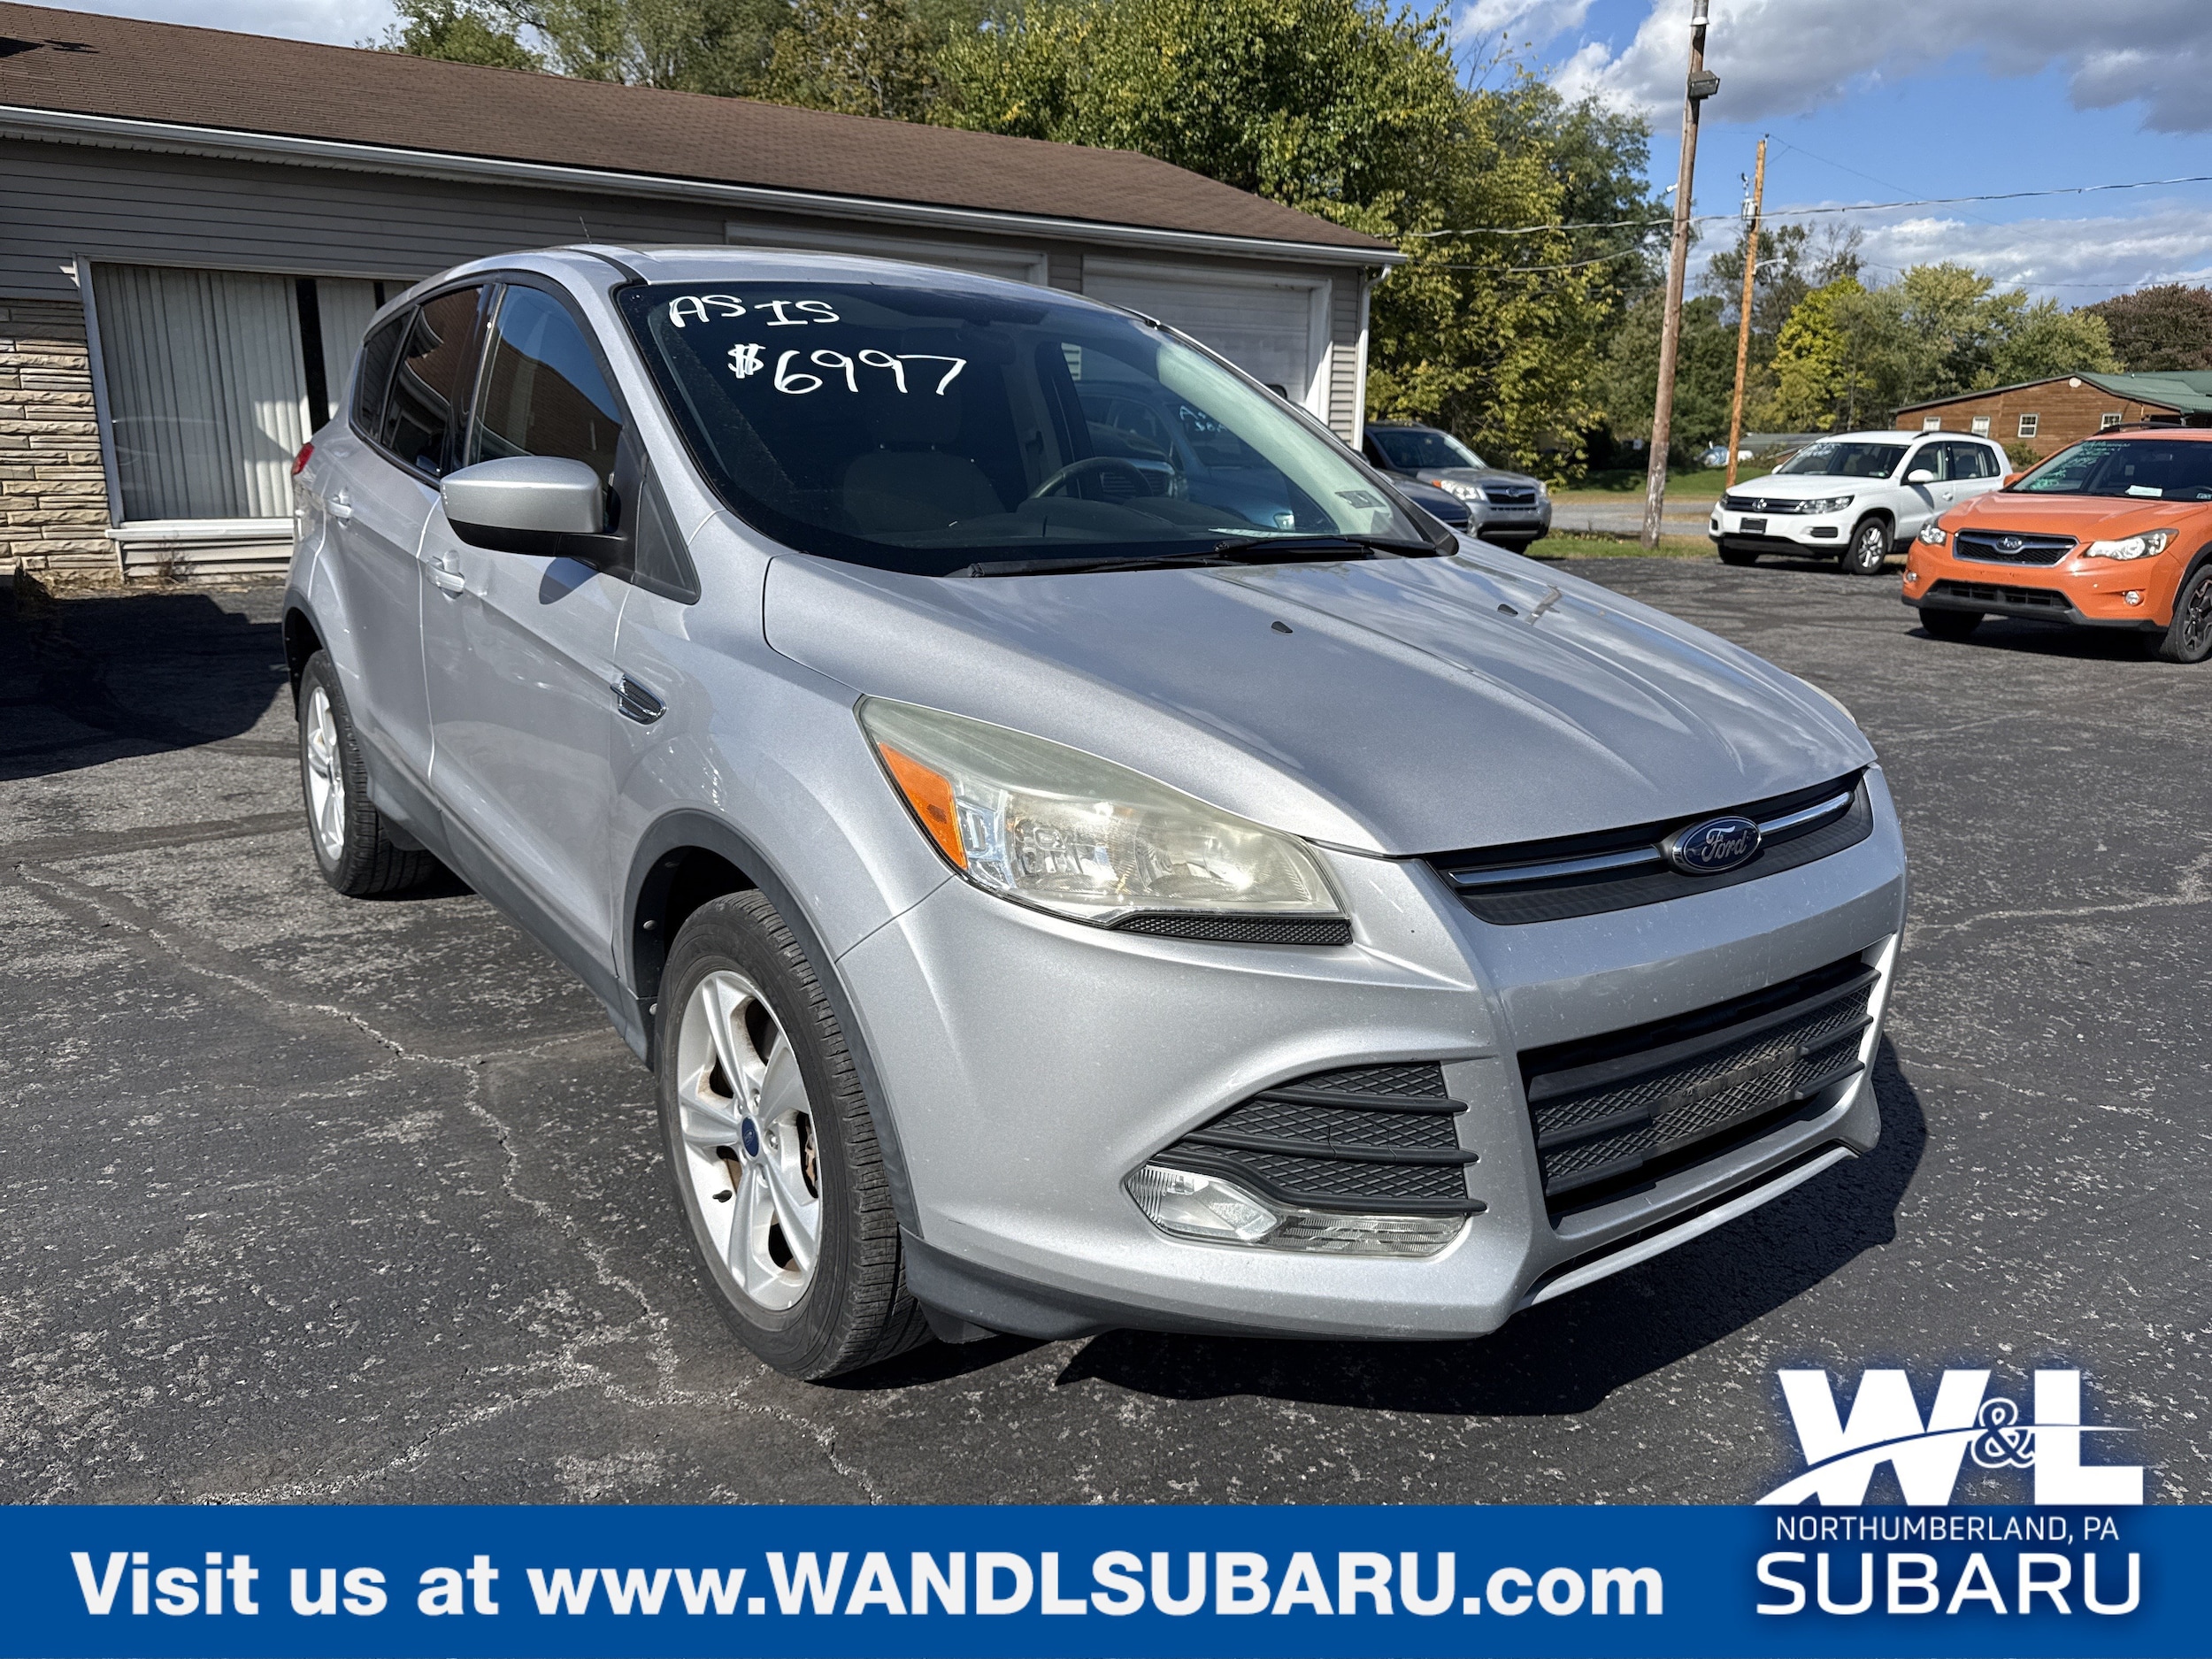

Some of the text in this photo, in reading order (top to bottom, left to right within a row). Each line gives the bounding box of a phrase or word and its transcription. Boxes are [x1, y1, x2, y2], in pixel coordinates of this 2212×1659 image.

[668, 294, 840, 328] AS IS
[727, 342, 967, 396] $6997
[1701, 826, 1748, 863] Ford
